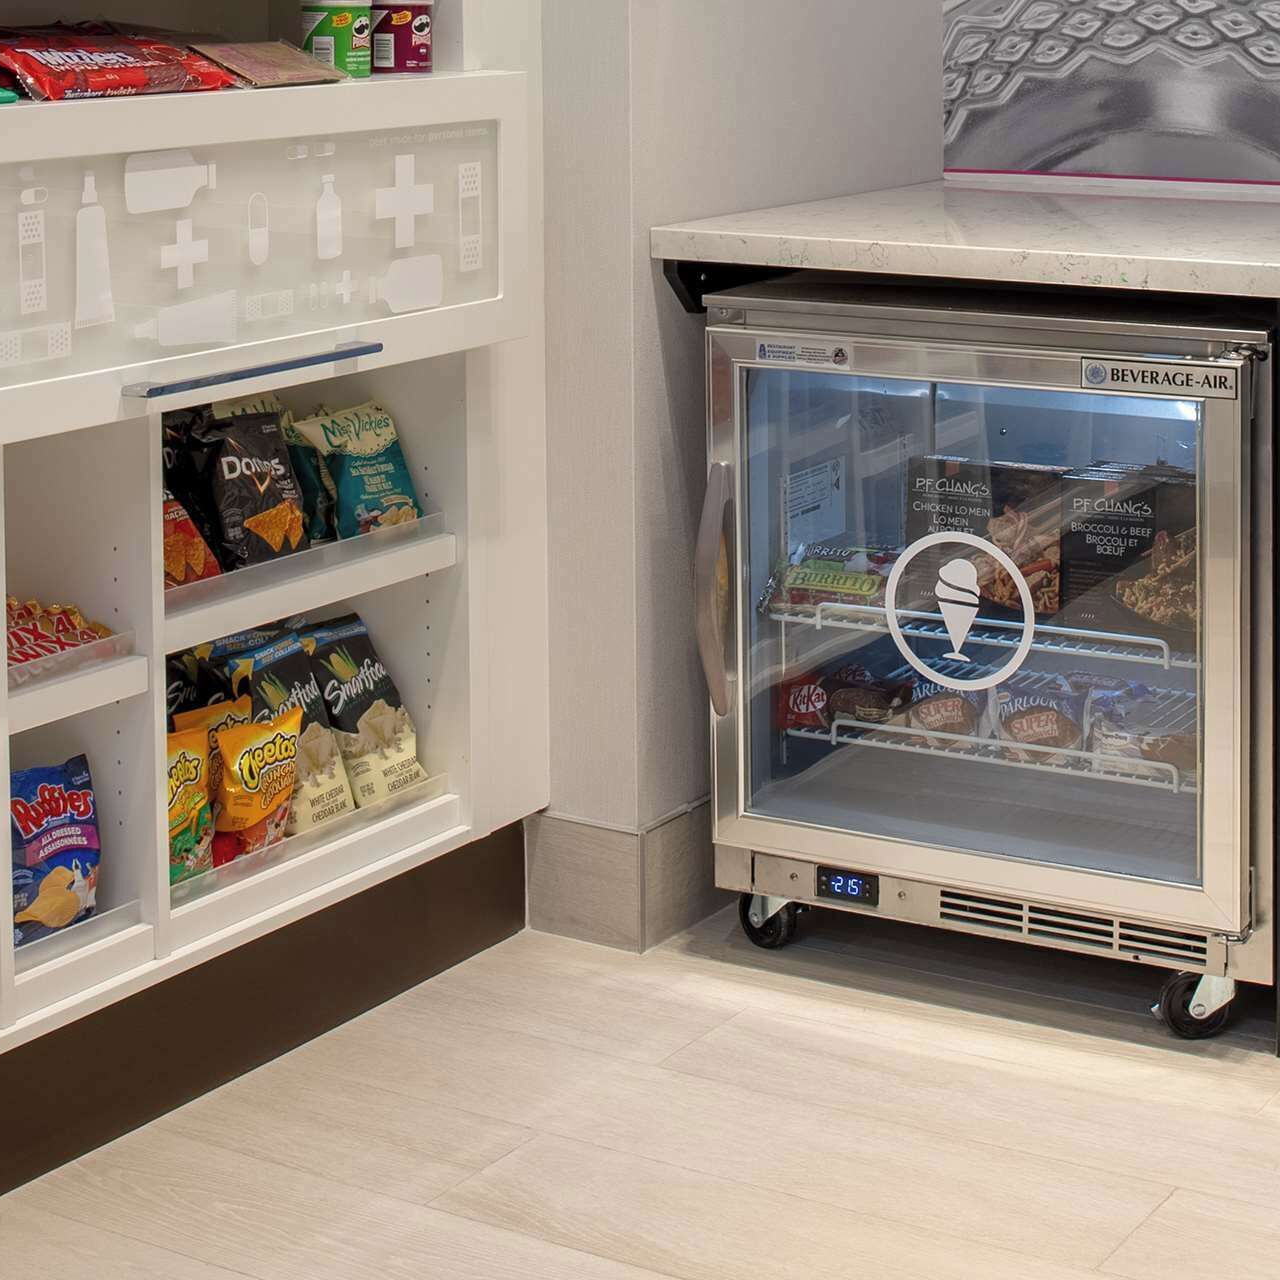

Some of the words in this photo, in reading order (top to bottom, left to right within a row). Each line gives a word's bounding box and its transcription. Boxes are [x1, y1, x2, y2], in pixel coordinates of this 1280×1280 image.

[1111, 367, 1229, 391] BEVERAGE-AIR
[221, 456, 285, 480] Doritos
[912, 500, 954, 513] CHICKEN
[955, 504, 968, 515] LO
[969, 507, 991, 518] MEIN
[933, 514, 945, 525] LO
[947, 516, 969, 527] MEIN
[1071, 522, 1119, 535] BROCCOLI
[1130, 527, 1153, 538] BEEF
[1086, 534, 1127, 548] BROCOLI
[1128, 539, 1138, 548] ET
[792, 571, 879, 593] BURRITO
[791, 684, 826, 712] KitKat
[920, 698, 962, 719] SUPER
[1010, 711, 1057, 733] SUPER
[11, 784, 94, 839] Ruffles
[41, 833, 52, 846] ALL
[53, 826, 81, 841] DRESSED
